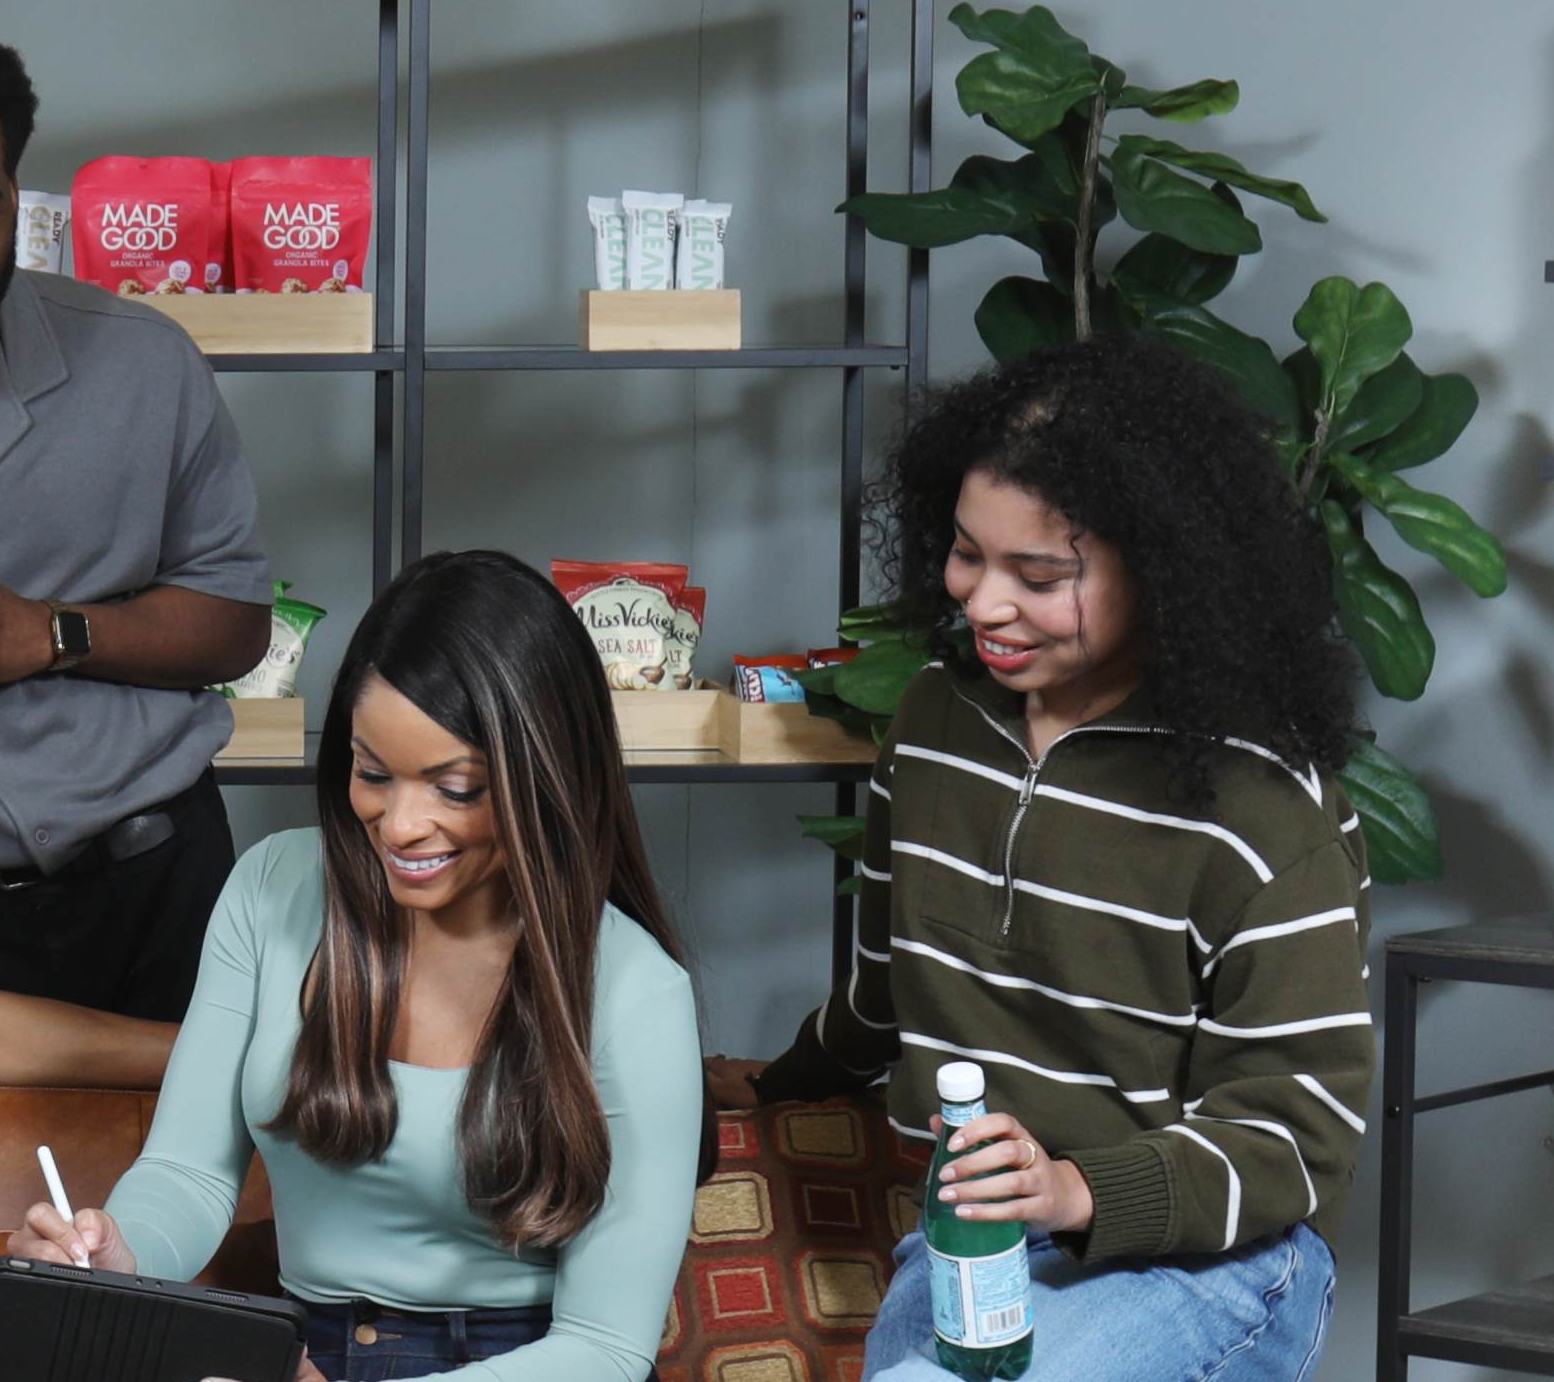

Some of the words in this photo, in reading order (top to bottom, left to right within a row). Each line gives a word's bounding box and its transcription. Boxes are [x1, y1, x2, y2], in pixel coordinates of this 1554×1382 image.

[102, 203, 179, 227] MADE
[263, 203, 340, 226] MADE
[52, 210, 62, 247] READY
[101, 227, 177, 251] GOOD
[263, 225, 340, 249] GOOD
[598, 638, 622, 654] SEA
[627, 638, 658, 654] SALT
